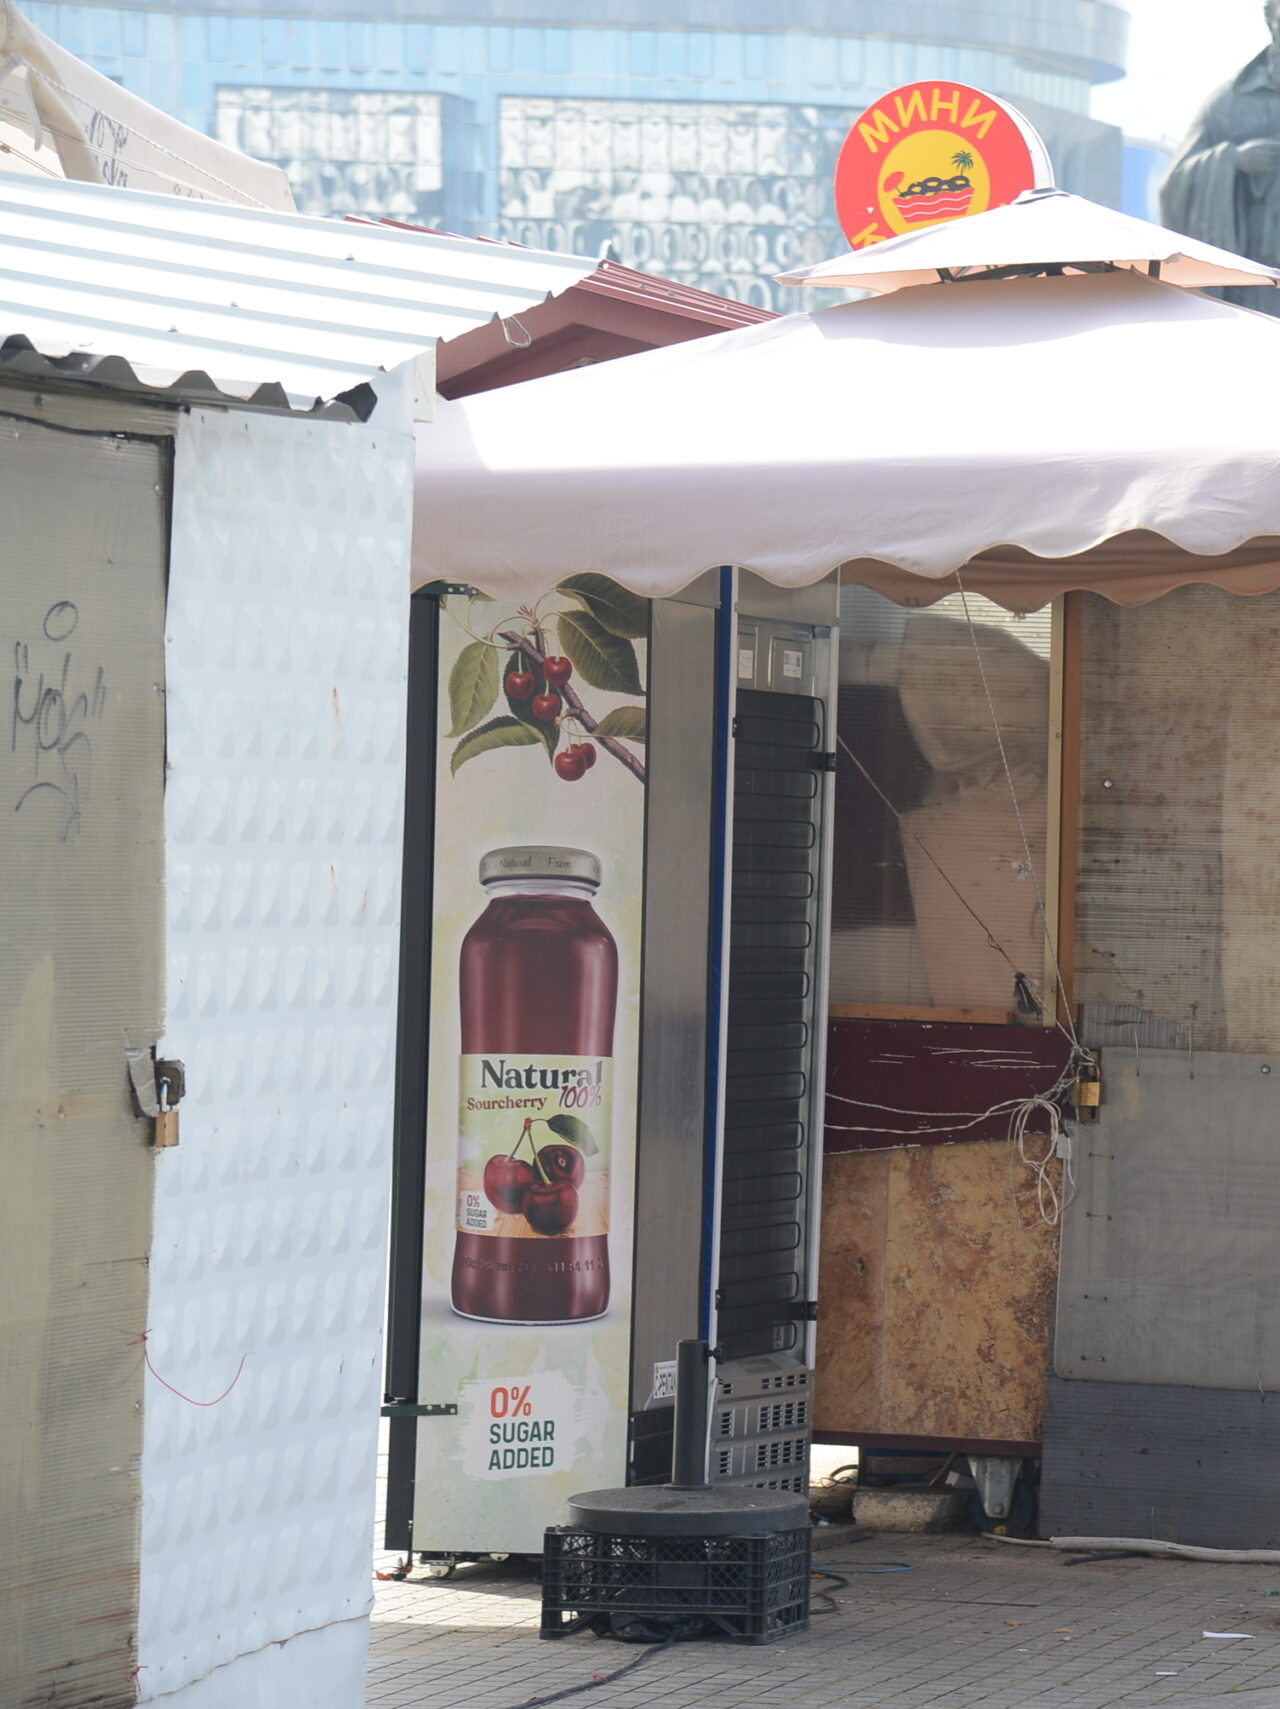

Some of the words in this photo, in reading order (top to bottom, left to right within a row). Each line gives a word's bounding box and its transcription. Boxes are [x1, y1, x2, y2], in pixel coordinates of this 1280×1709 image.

[858, 88, 997, 153] МИНИ
[480, 1059, 603, 1089] Natural
[467, 1096, 548, 1111] Sourcherry
[559, 1083, 602, 1109] 100%
[466, 1194, 480, 1208] 0%
[466, 1208, 488, 1219] SUGAR
[466, 1218, 488, 1229] ADDED
[489, 1385, 532, 1418] 0%
[489, 1420, 555, 1444] SUGAR
[488, 1446, 554, 1470] ADDED
